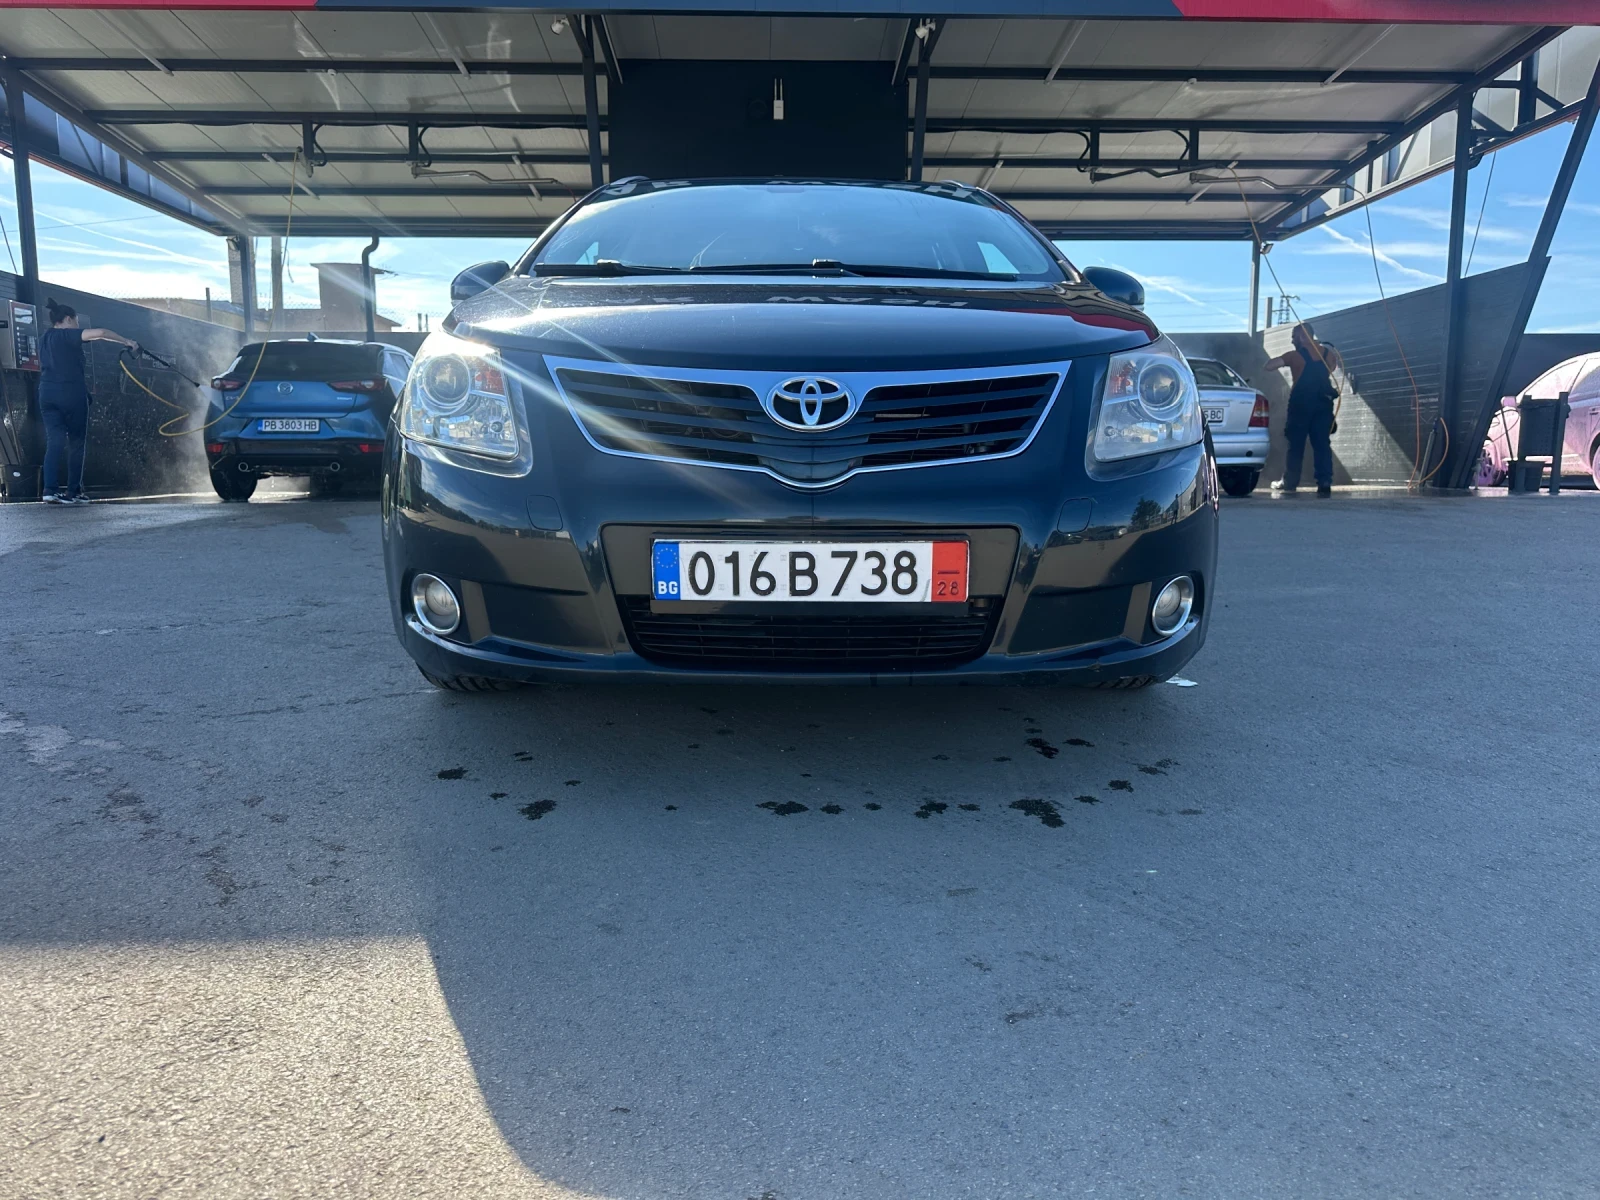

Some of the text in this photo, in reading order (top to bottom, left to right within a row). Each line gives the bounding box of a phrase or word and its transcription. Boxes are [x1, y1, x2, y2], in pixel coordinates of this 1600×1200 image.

[1210, 410, 1222, 419] BC
[264, 420, 317, 430] PB 3803 HB
[658, 581, 678, 594] BG
[937, 581, 959, 596] 28
